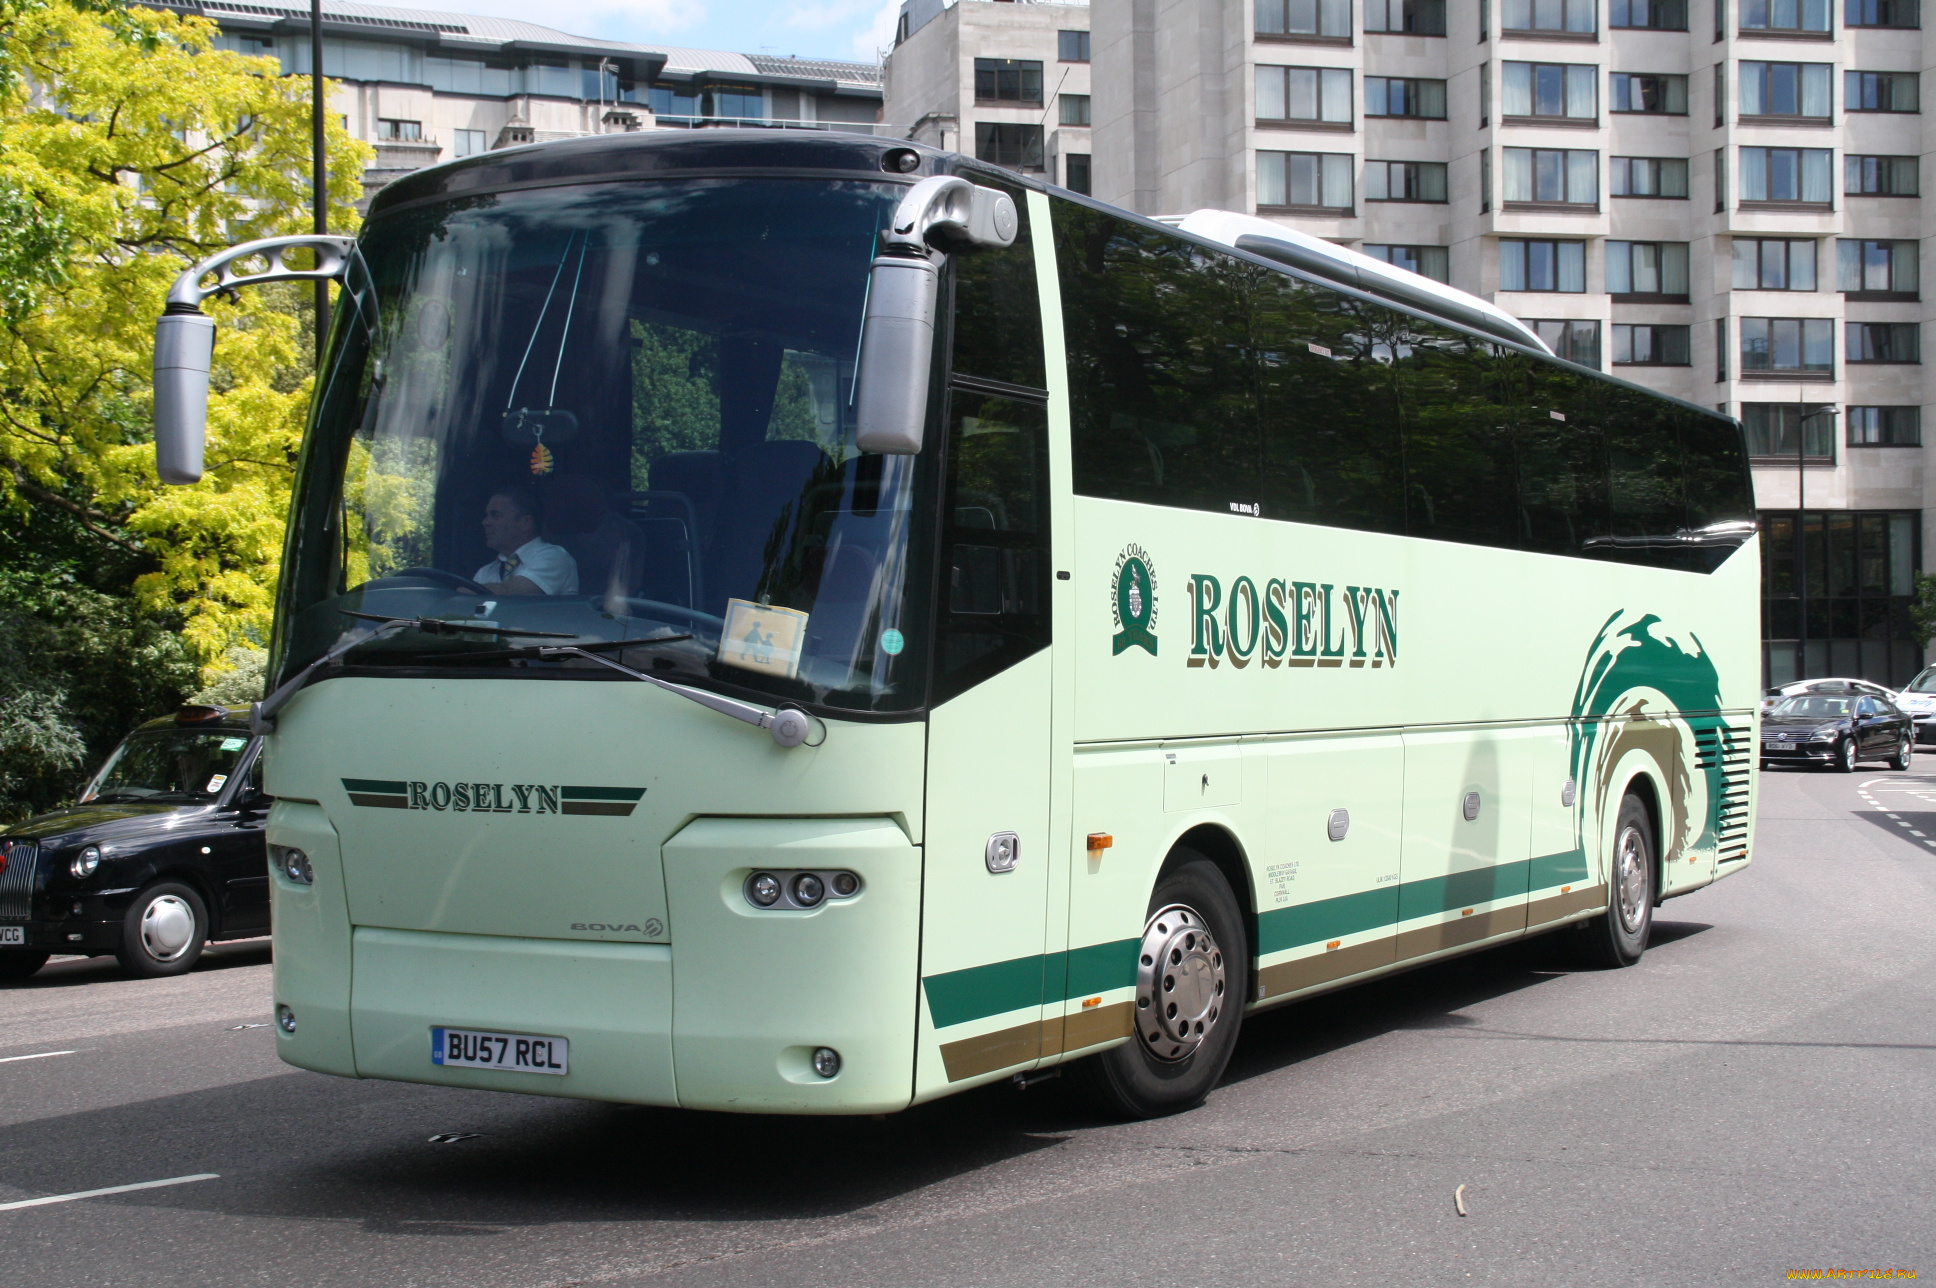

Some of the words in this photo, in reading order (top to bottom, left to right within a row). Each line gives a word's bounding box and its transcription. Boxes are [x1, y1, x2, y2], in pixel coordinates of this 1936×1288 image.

[1240, 503, 1253, 514] BOVA
[1110, 548, 1126, 629] ROSELYN
[1127, 543, 1158, 591] COACHES
[1187, 573, 1400, 669] ROSELYN
[408, 781, 560, 815] ROSELYN
[570, 922, 641, 932] BOVA
[448, 1033, 509, 1064] BU57
[516, 1039, 562, 1069] RCL
